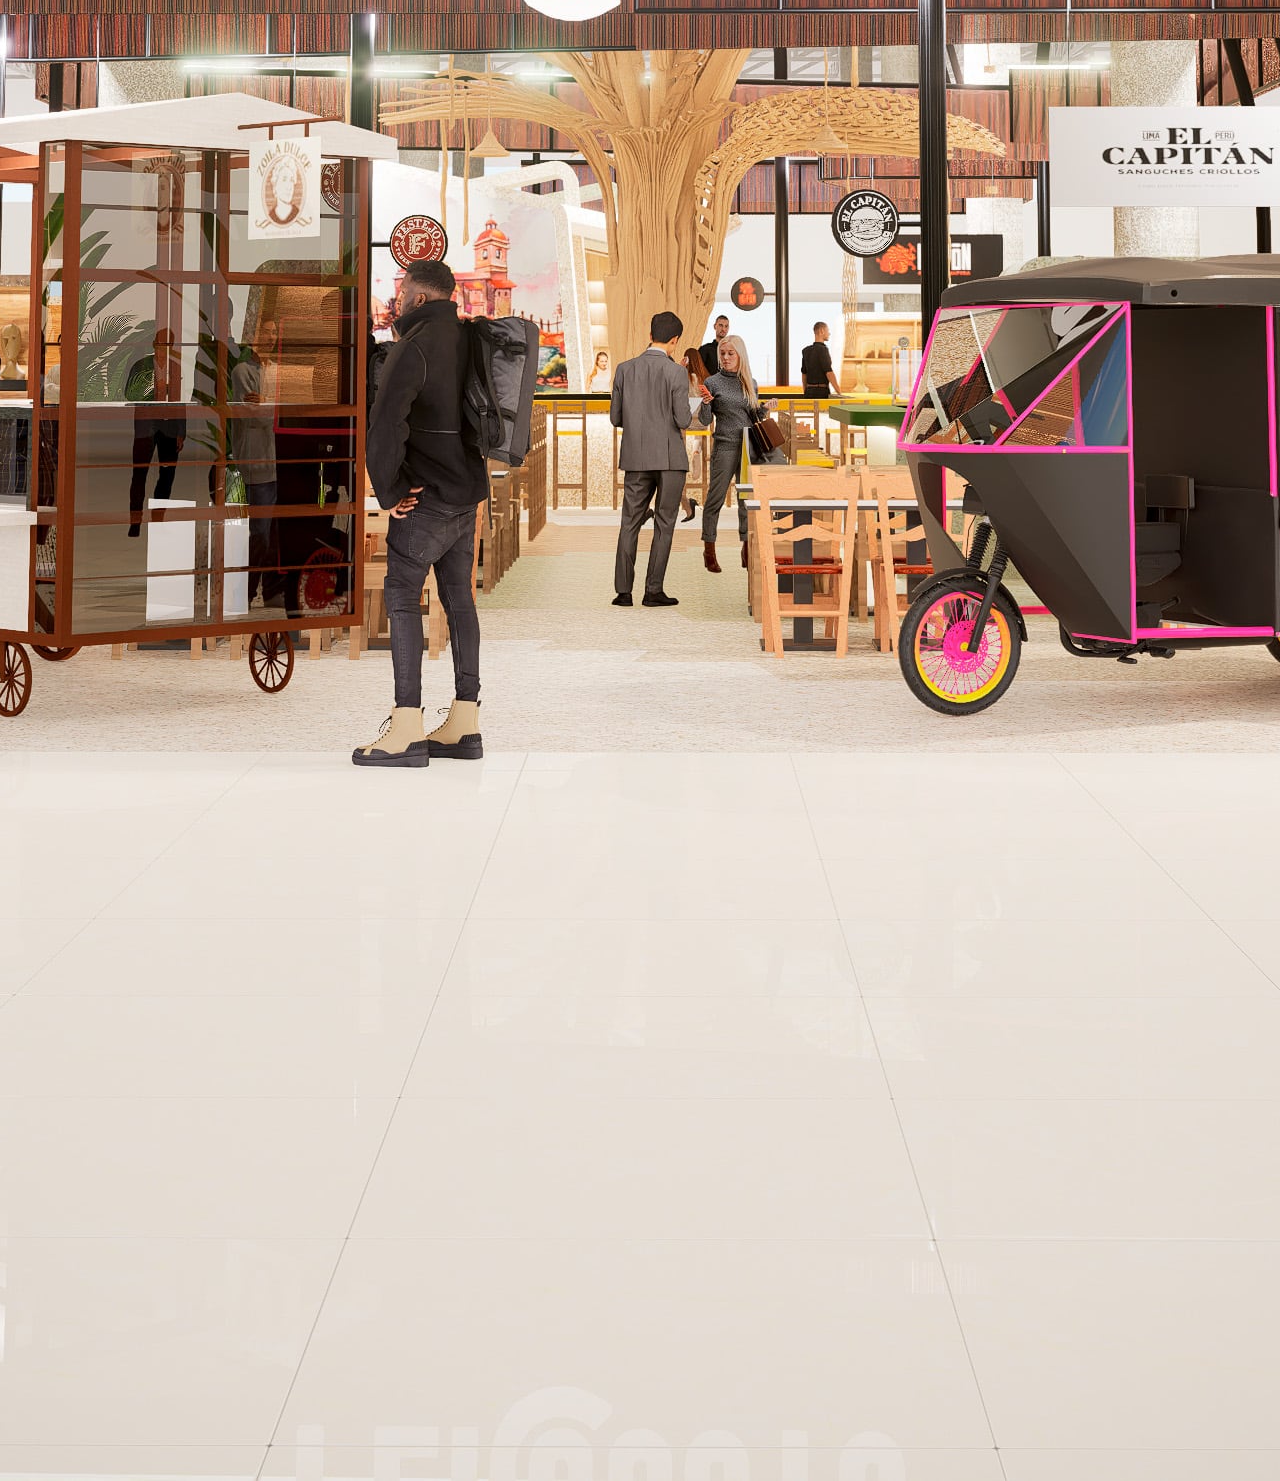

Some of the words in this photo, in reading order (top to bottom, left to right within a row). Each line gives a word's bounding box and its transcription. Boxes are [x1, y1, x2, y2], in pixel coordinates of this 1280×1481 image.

[1142, 131, 1160, 140] LIMA
[1167, 127, 1212, 145] EL
[257, 143, 281, 177] ZOILA
[1102, 142, 1275, 165] CAPITÁN
[841, 208, 853, 223] EL
[395, 218, 441, 239] FESTEJO
